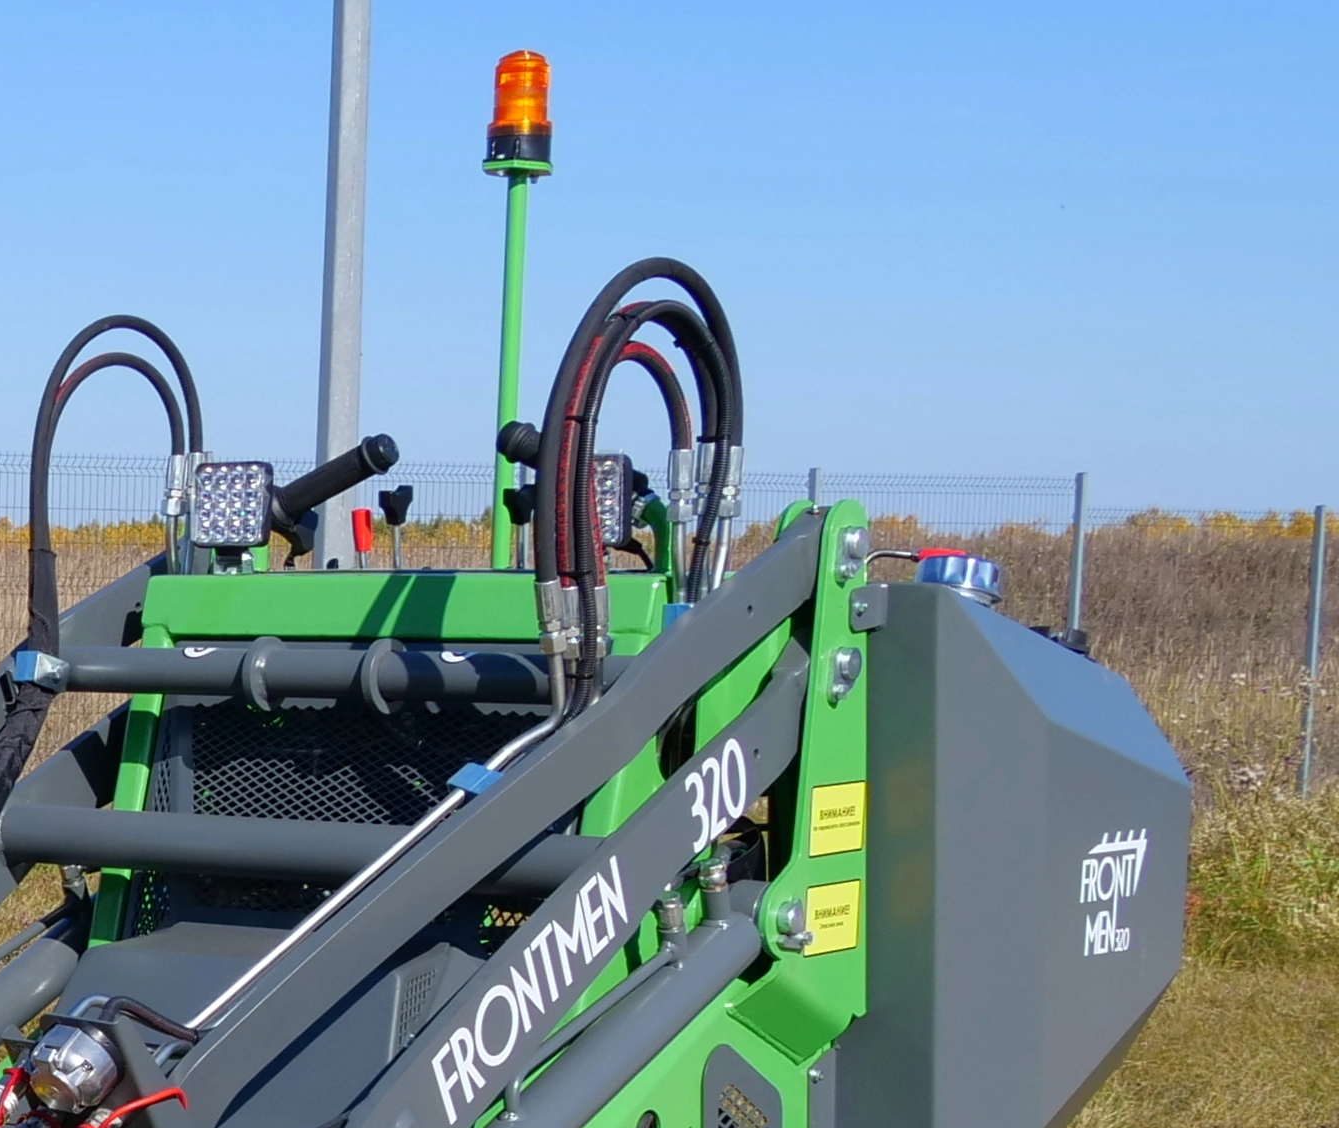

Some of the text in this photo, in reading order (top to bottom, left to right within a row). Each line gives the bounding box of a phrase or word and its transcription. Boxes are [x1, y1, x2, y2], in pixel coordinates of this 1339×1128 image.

[685, 738, 746, 853] 320
[1080, 853, 1136, 903] FRONT
[1084, 910, 1130, 956] MEN 320
[431, 855, 628, 1125] FRONTMEN
